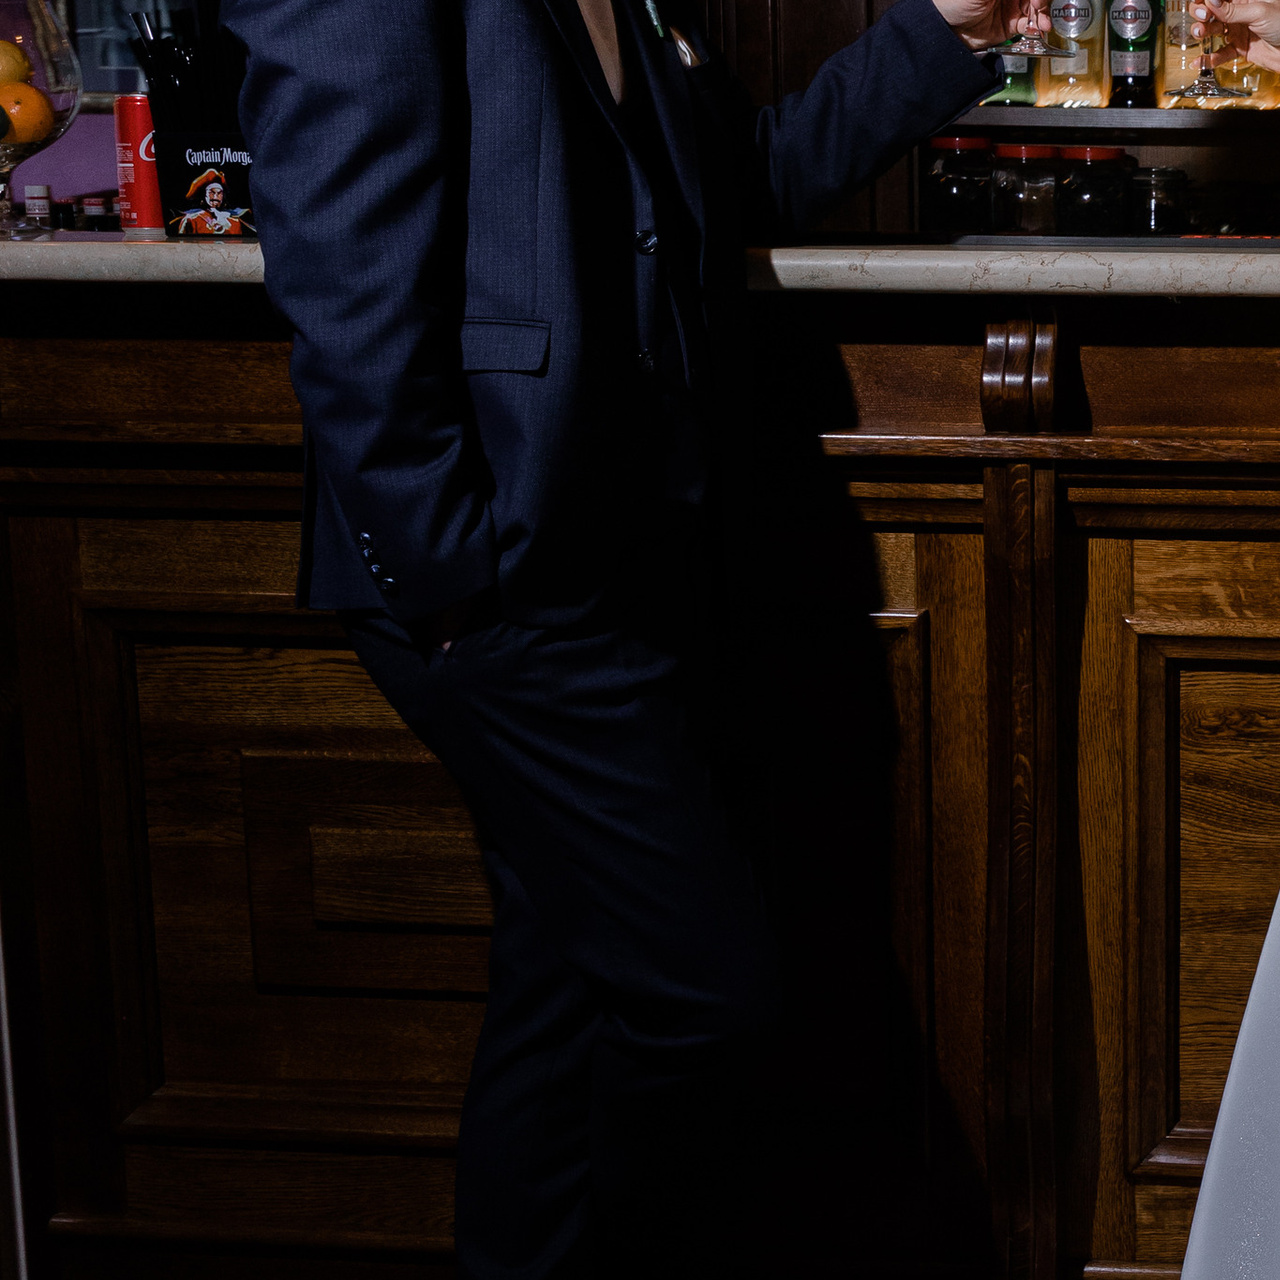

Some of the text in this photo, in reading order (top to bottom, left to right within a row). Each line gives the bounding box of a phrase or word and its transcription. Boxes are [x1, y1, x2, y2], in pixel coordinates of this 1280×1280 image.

[1053, 8, 1089, 18] MARTINI
[1112, 10, 1149, 20] MARTINI
[185, 147, 253, 166] Captain Morga
